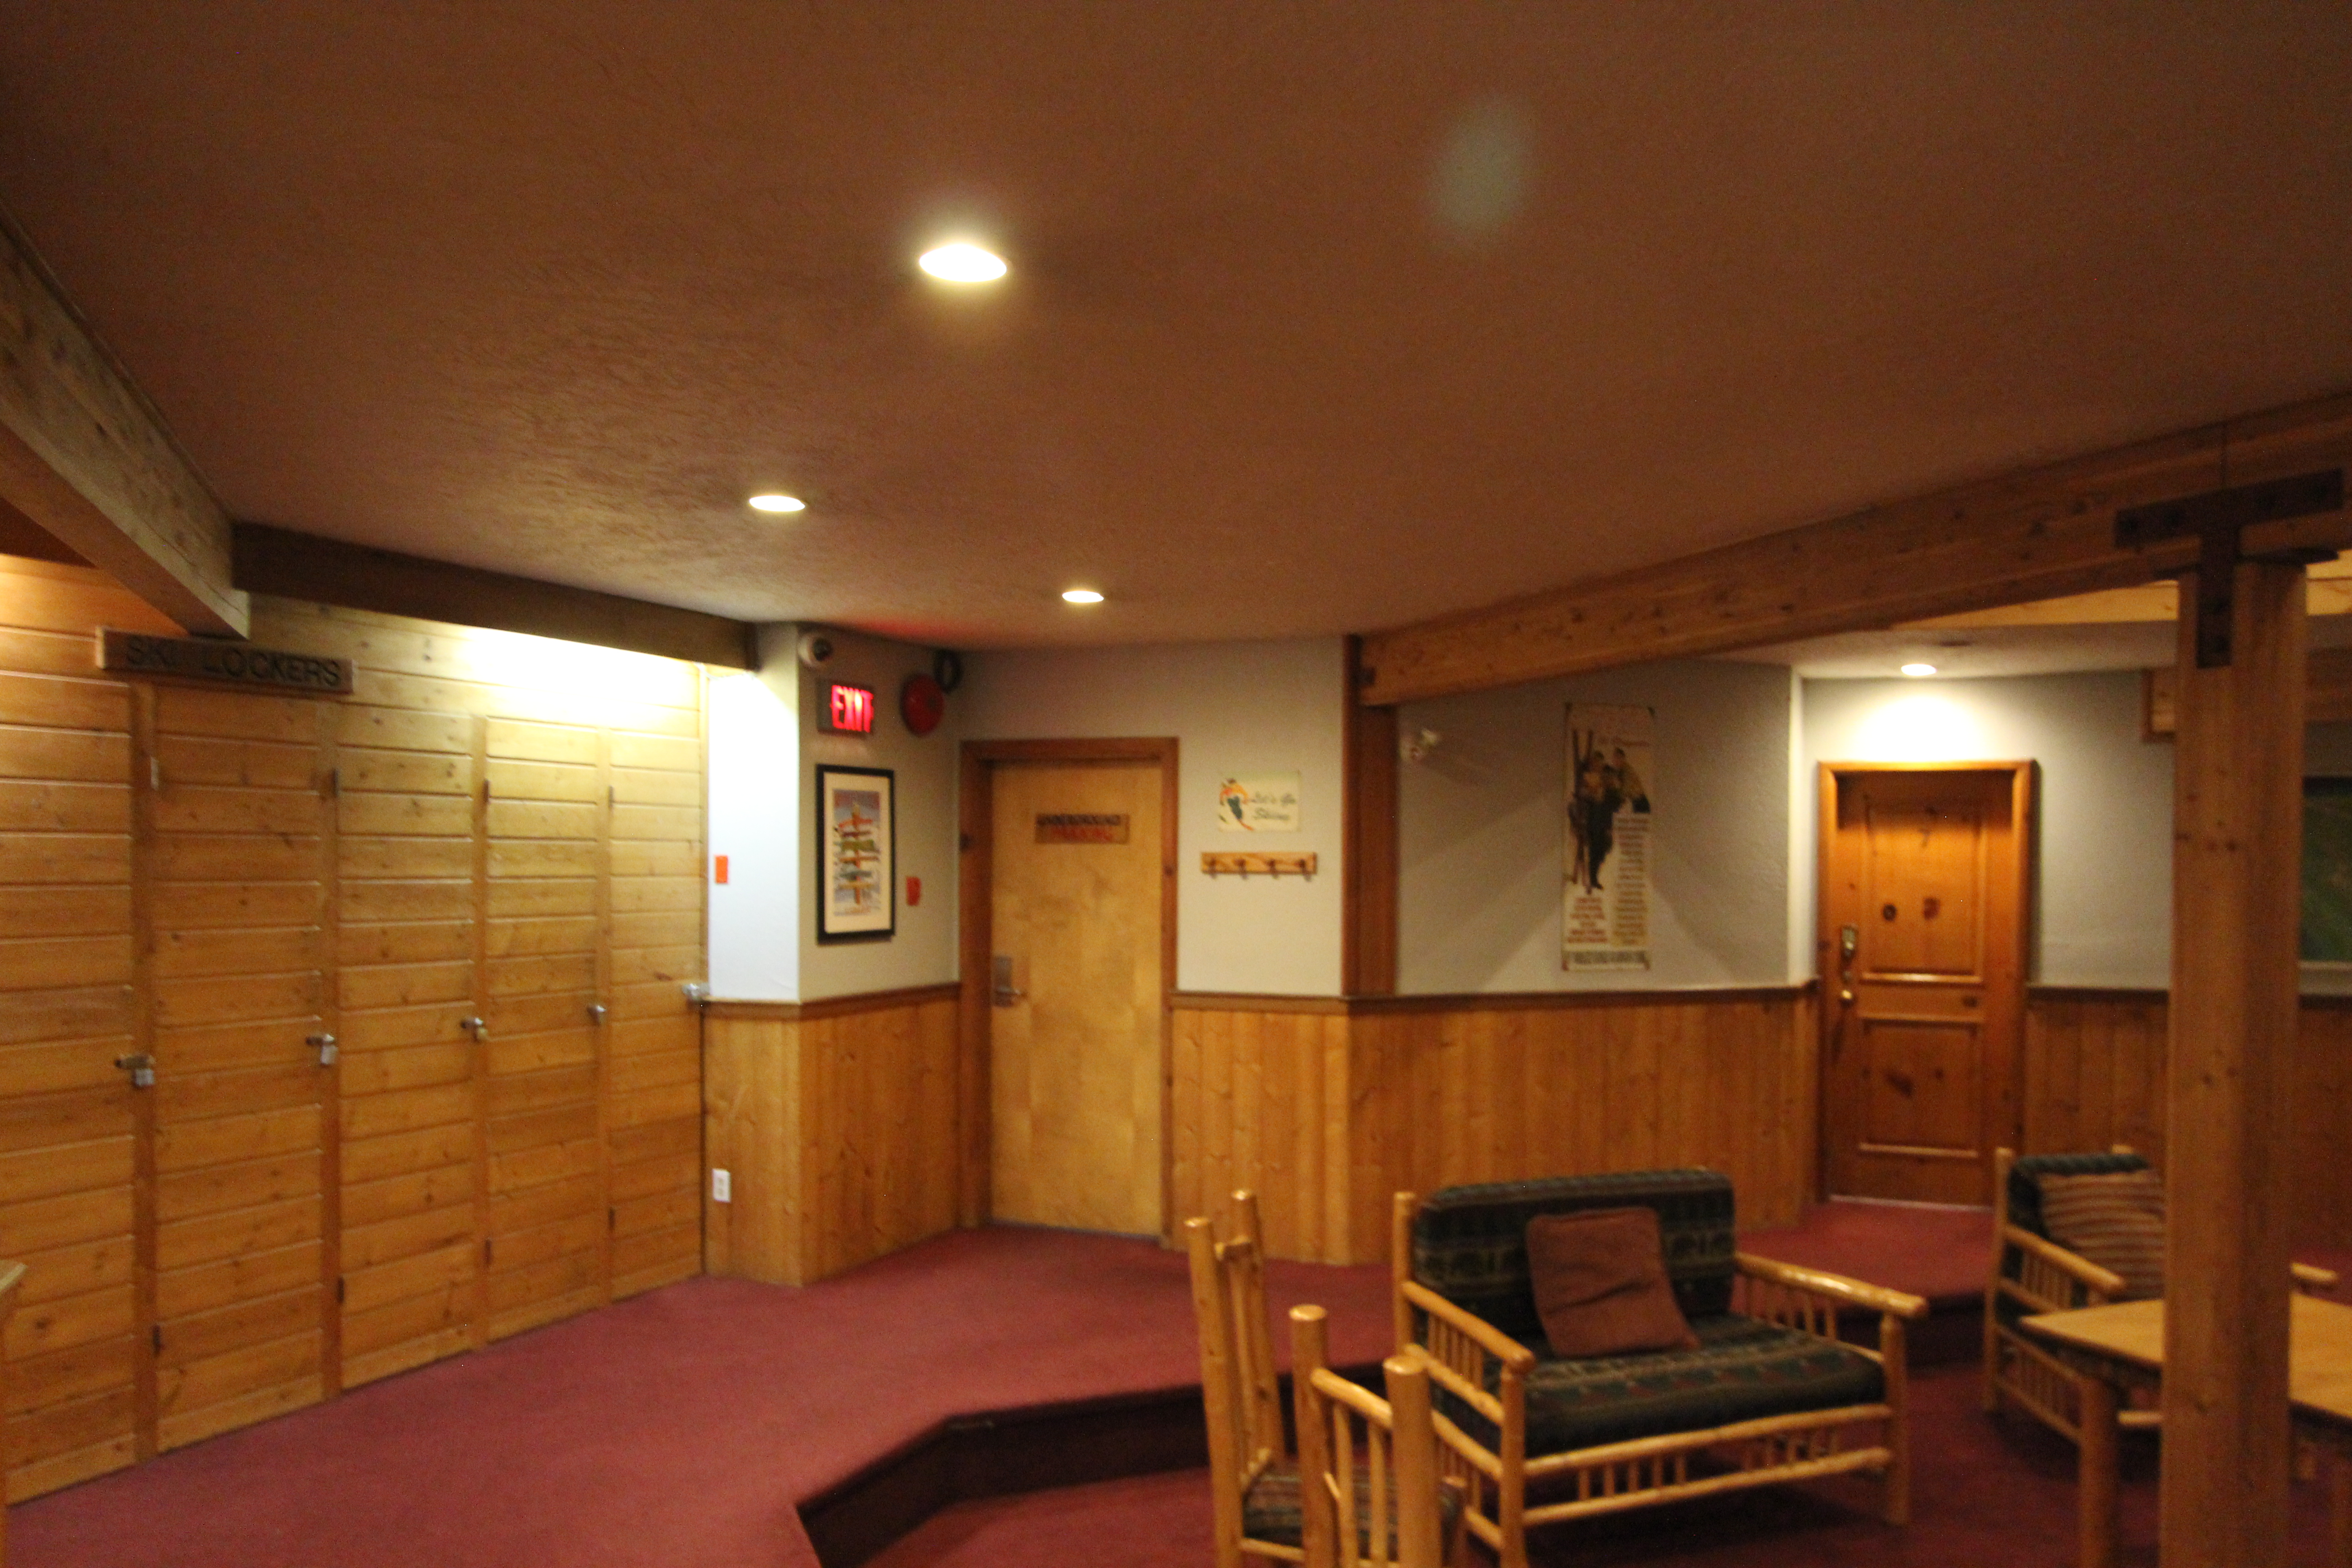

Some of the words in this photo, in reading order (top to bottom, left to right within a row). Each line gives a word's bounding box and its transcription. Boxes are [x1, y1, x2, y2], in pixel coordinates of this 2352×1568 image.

[127, 635, 177, 667] SKI
[202, 645, 342, 687] LOCKERS
[831, 685, 874, 733] EXIT
